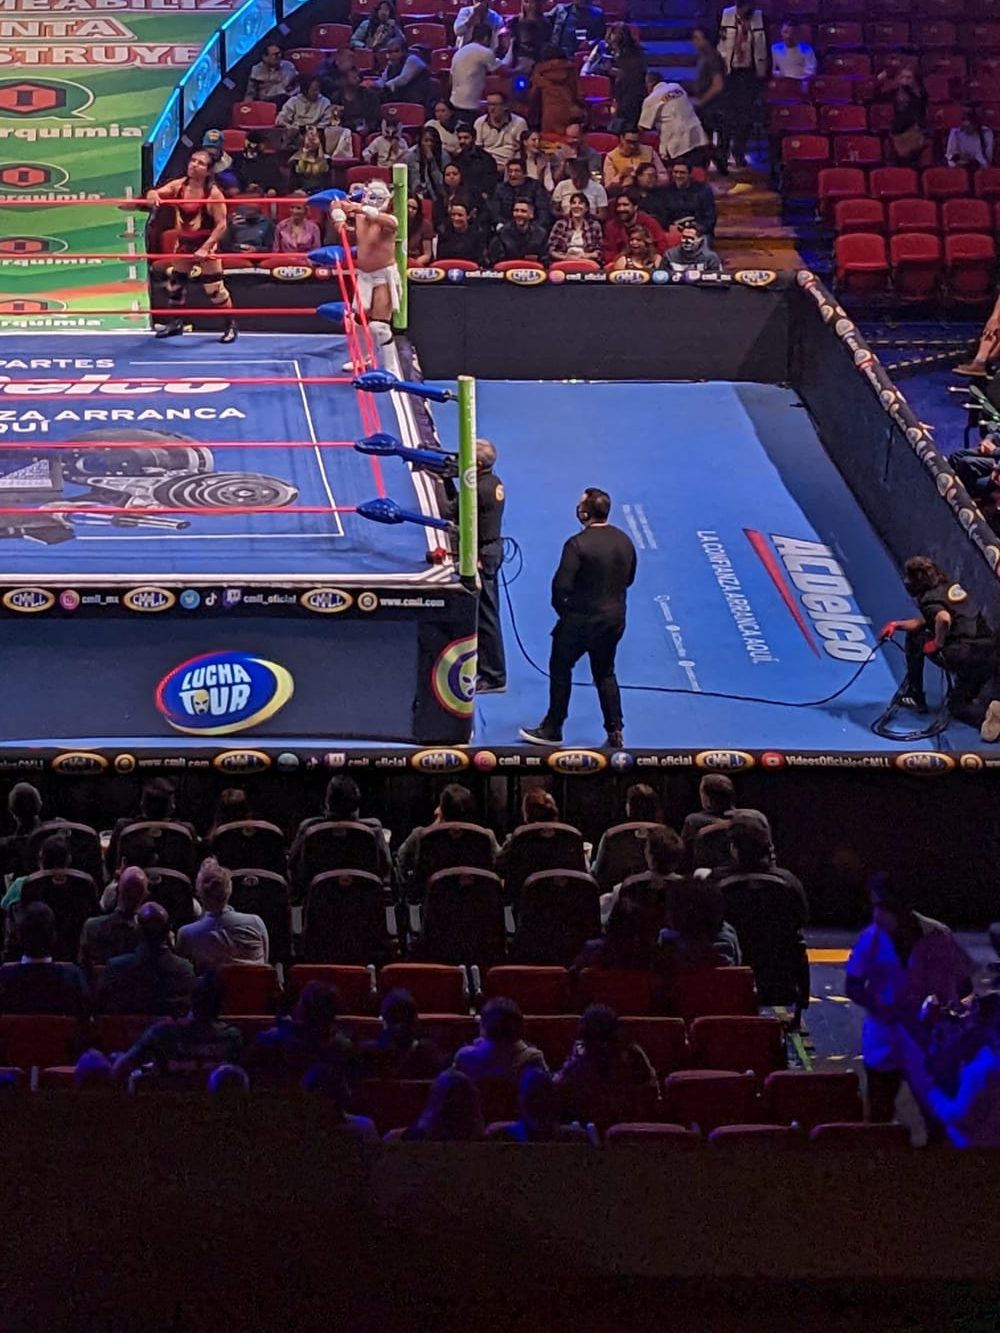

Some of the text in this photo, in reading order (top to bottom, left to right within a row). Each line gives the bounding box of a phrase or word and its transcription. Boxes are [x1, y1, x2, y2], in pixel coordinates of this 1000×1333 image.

[54, 407, 247, 421] ARRANCA
[12, 593, 46, 608] CMLL
[132, 593, 166, 608] CMLL
[309, 594, 344, 609] CMLL
[769, 533, 876, 663] ACDelco
[181, 663, 252, 691] LUCHA
[138, 757, 210, 767] www.cmllcom
